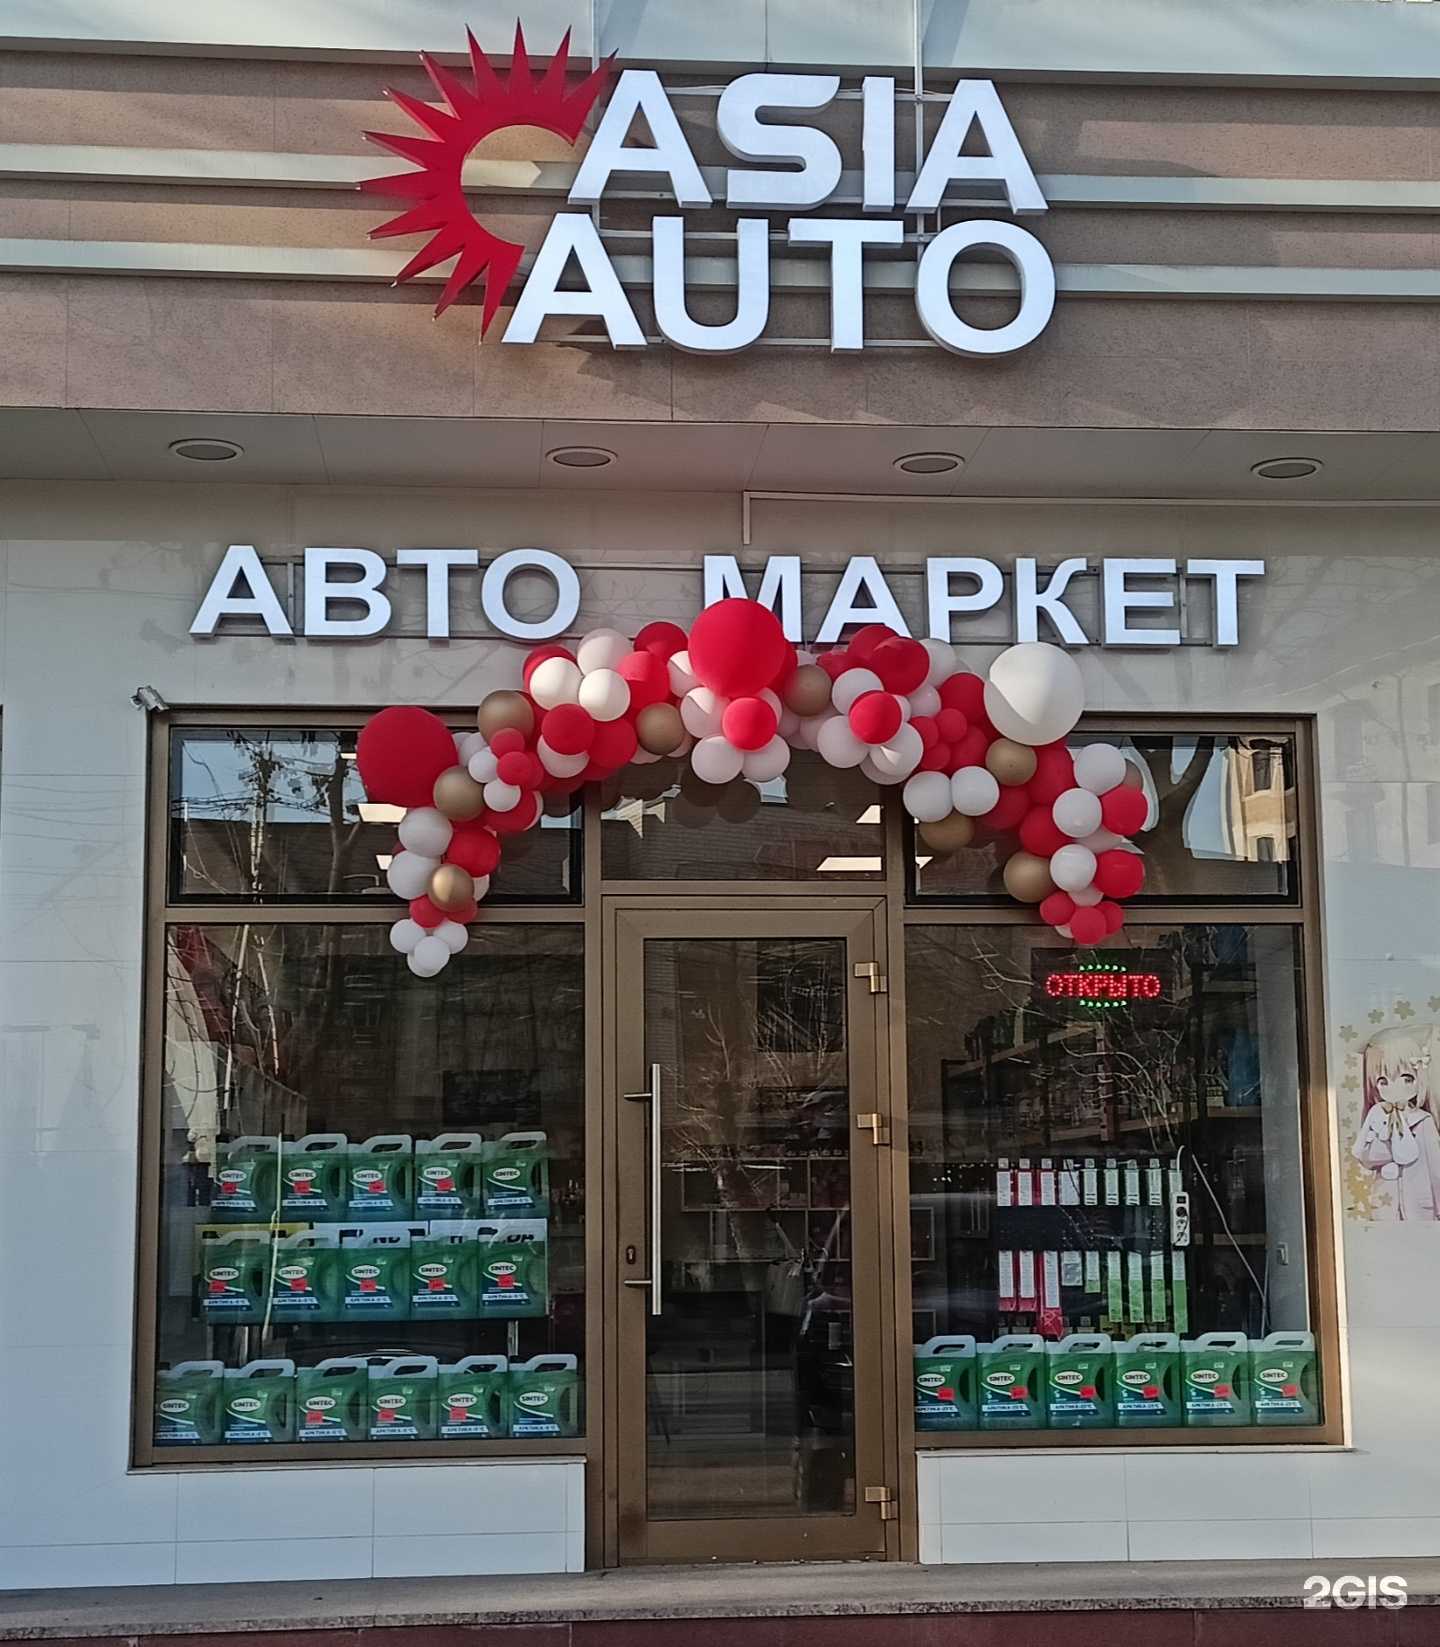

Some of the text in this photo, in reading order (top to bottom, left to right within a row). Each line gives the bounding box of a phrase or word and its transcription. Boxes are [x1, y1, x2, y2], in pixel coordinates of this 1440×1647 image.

[568, 69, 1048, 214] ASIA
[502, 212, 1056, 358] AUTO
[188, 544, 1265, 647] АВТО МАРКЕТ
[1045, 974, 1161, 997] ОТКРЫТО
